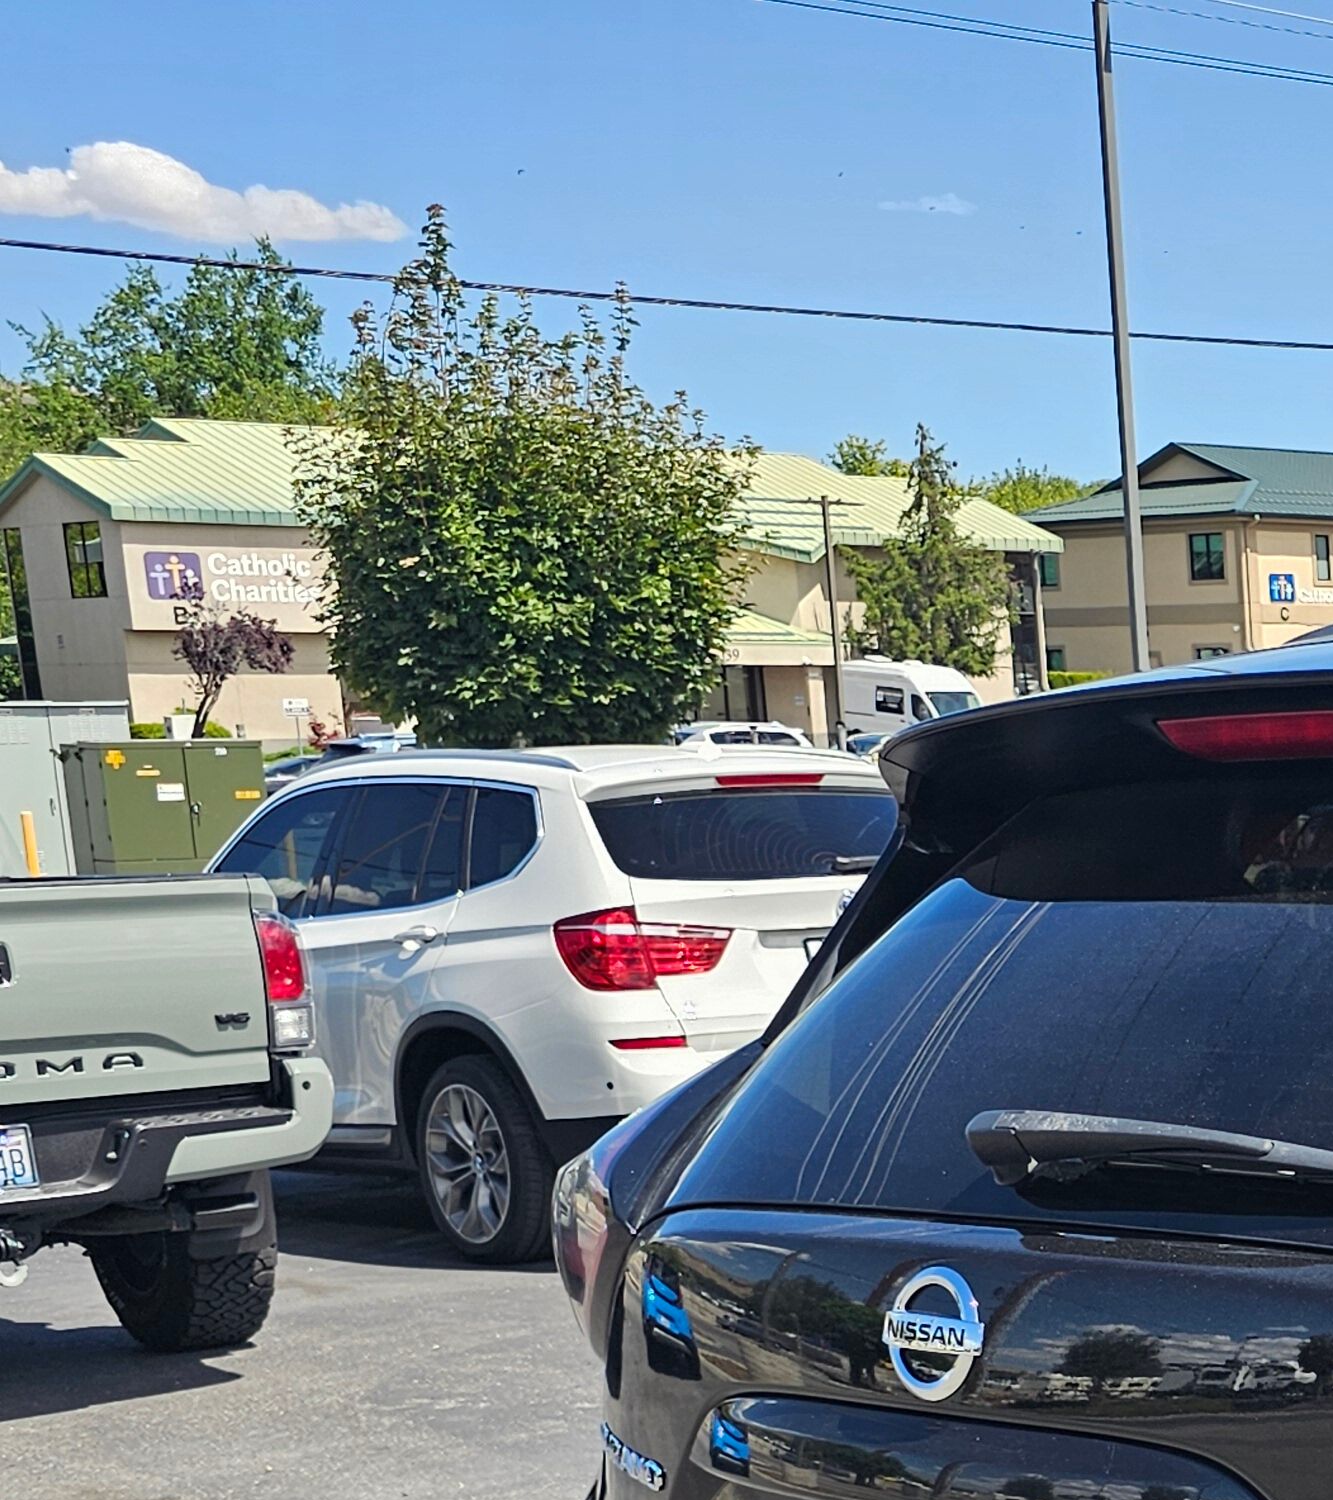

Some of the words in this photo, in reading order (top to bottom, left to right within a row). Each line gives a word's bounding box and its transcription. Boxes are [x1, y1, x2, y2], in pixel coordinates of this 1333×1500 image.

[207, 552, 311, 577] Catholic
[210, 579, 322, 603] Charities
[1280, 607, 1290, 621] C
[214, 1012, 250, 1025] V6
[887, 1318, 965, 1347] NISSAN
